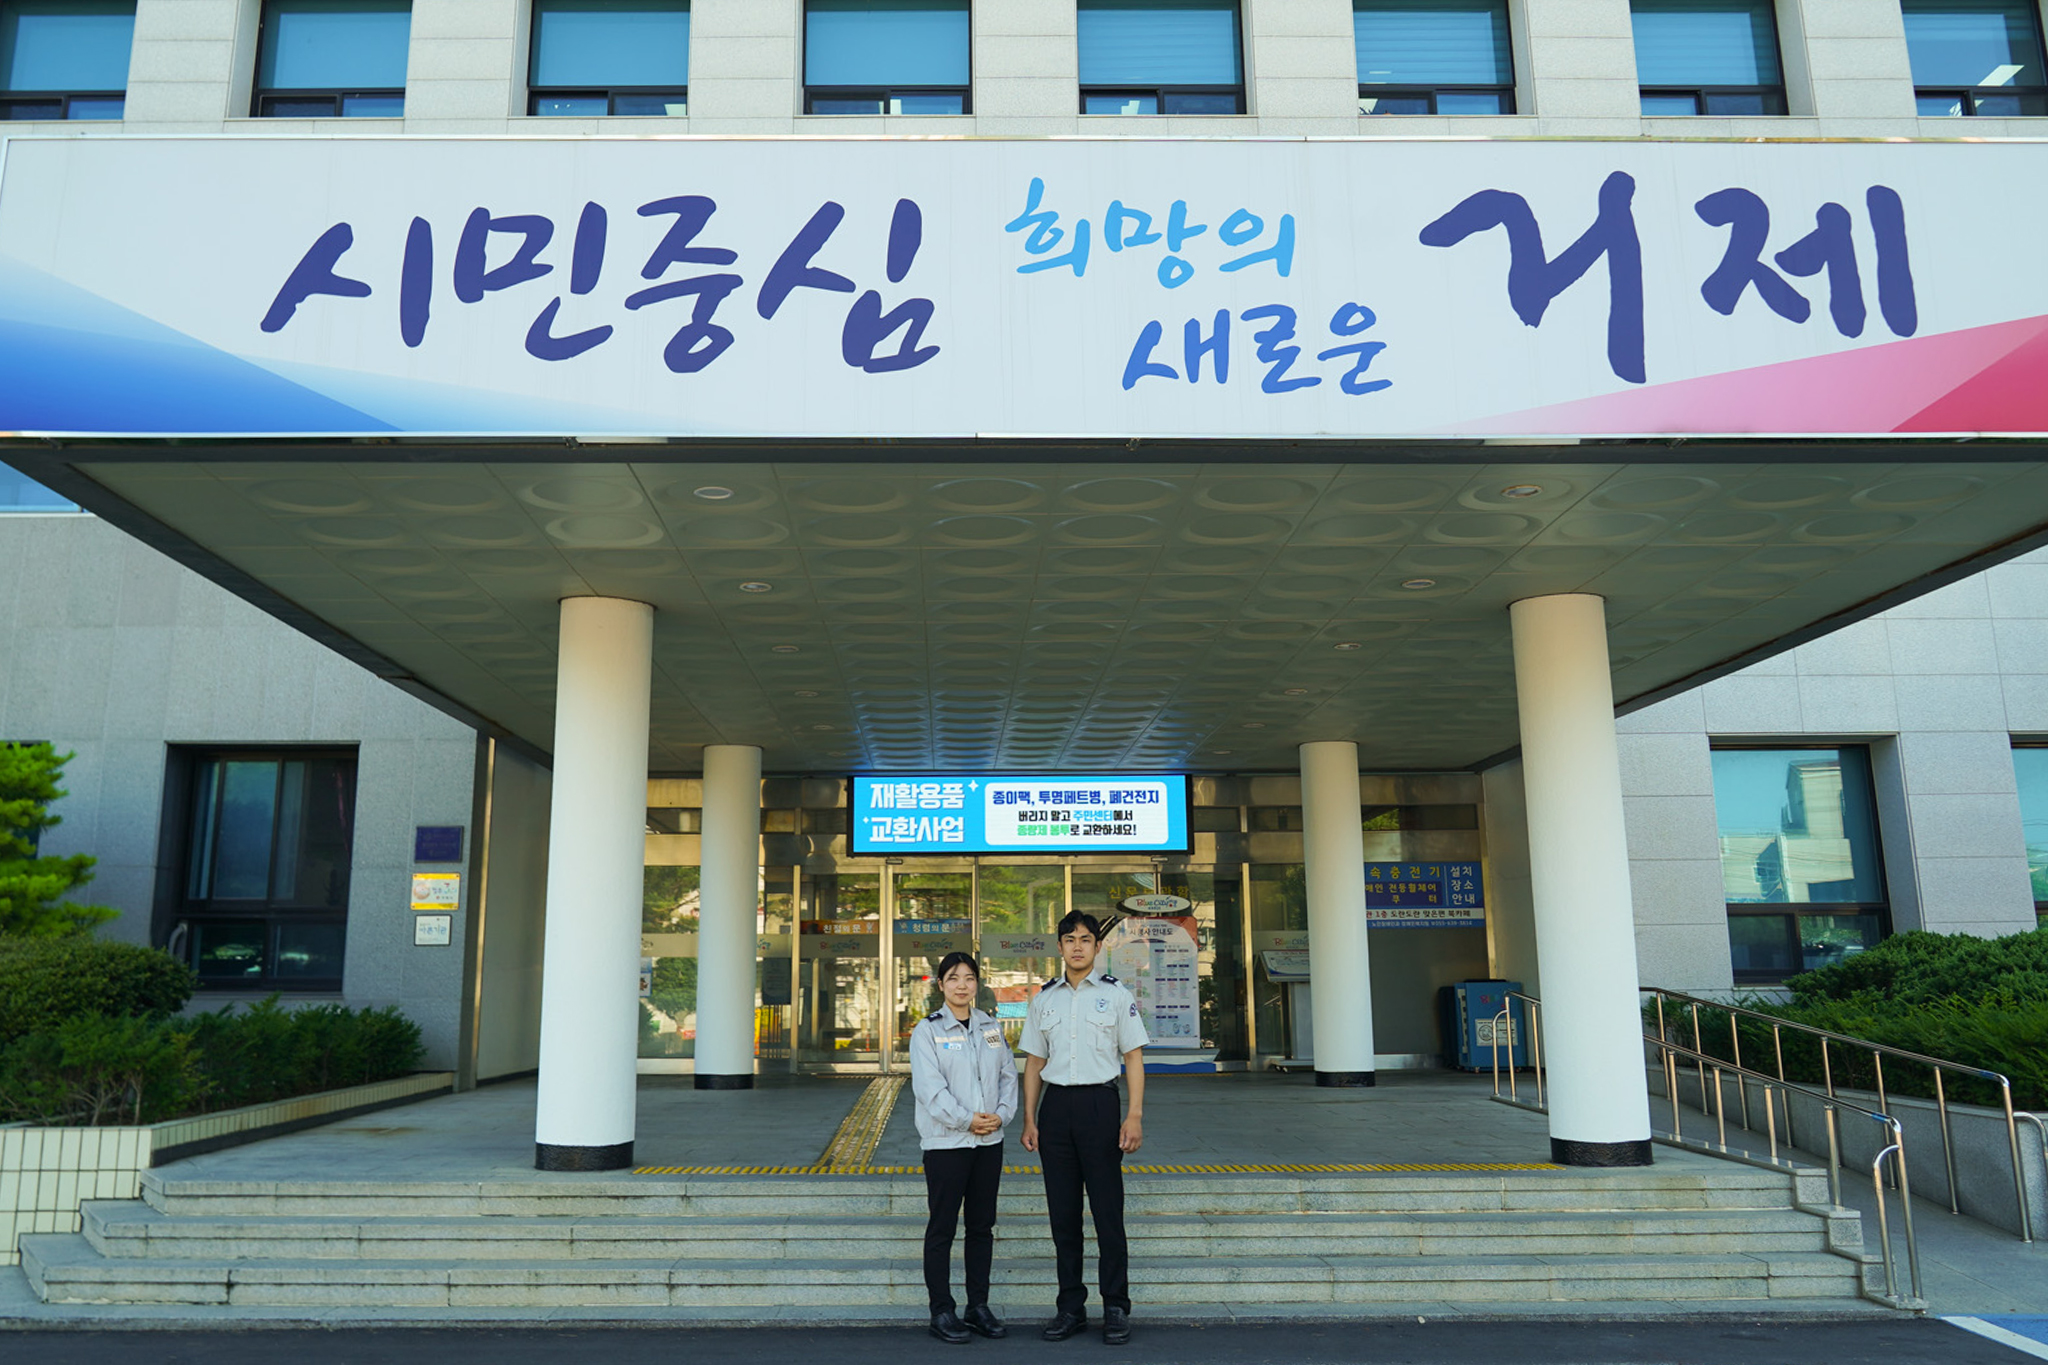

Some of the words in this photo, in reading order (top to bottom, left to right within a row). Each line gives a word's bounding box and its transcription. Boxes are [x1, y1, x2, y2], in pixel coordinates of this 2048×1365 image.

[1004, 176, 1296, 290] 희망의
[260, 195, 941, 374] 시민중심
[1418, 170, 1918, 384] 거제
[1122, 301, 1393, 396] 새로운
[870, 783, 965, 809] 재활용품
[992, 790, 1035, 806] 종이팩,
[1038, 790, 1106, 806] 투명페트병,
[1109, 790, 1160, 804] 폐건전지
[869, 816, 965, 843] 교환사업
[1018, 810, 1048, 822] 버리지
[1050, 810, 1071, 822] 말고
[1082, 824, 1137, 836] 교환하세요!
